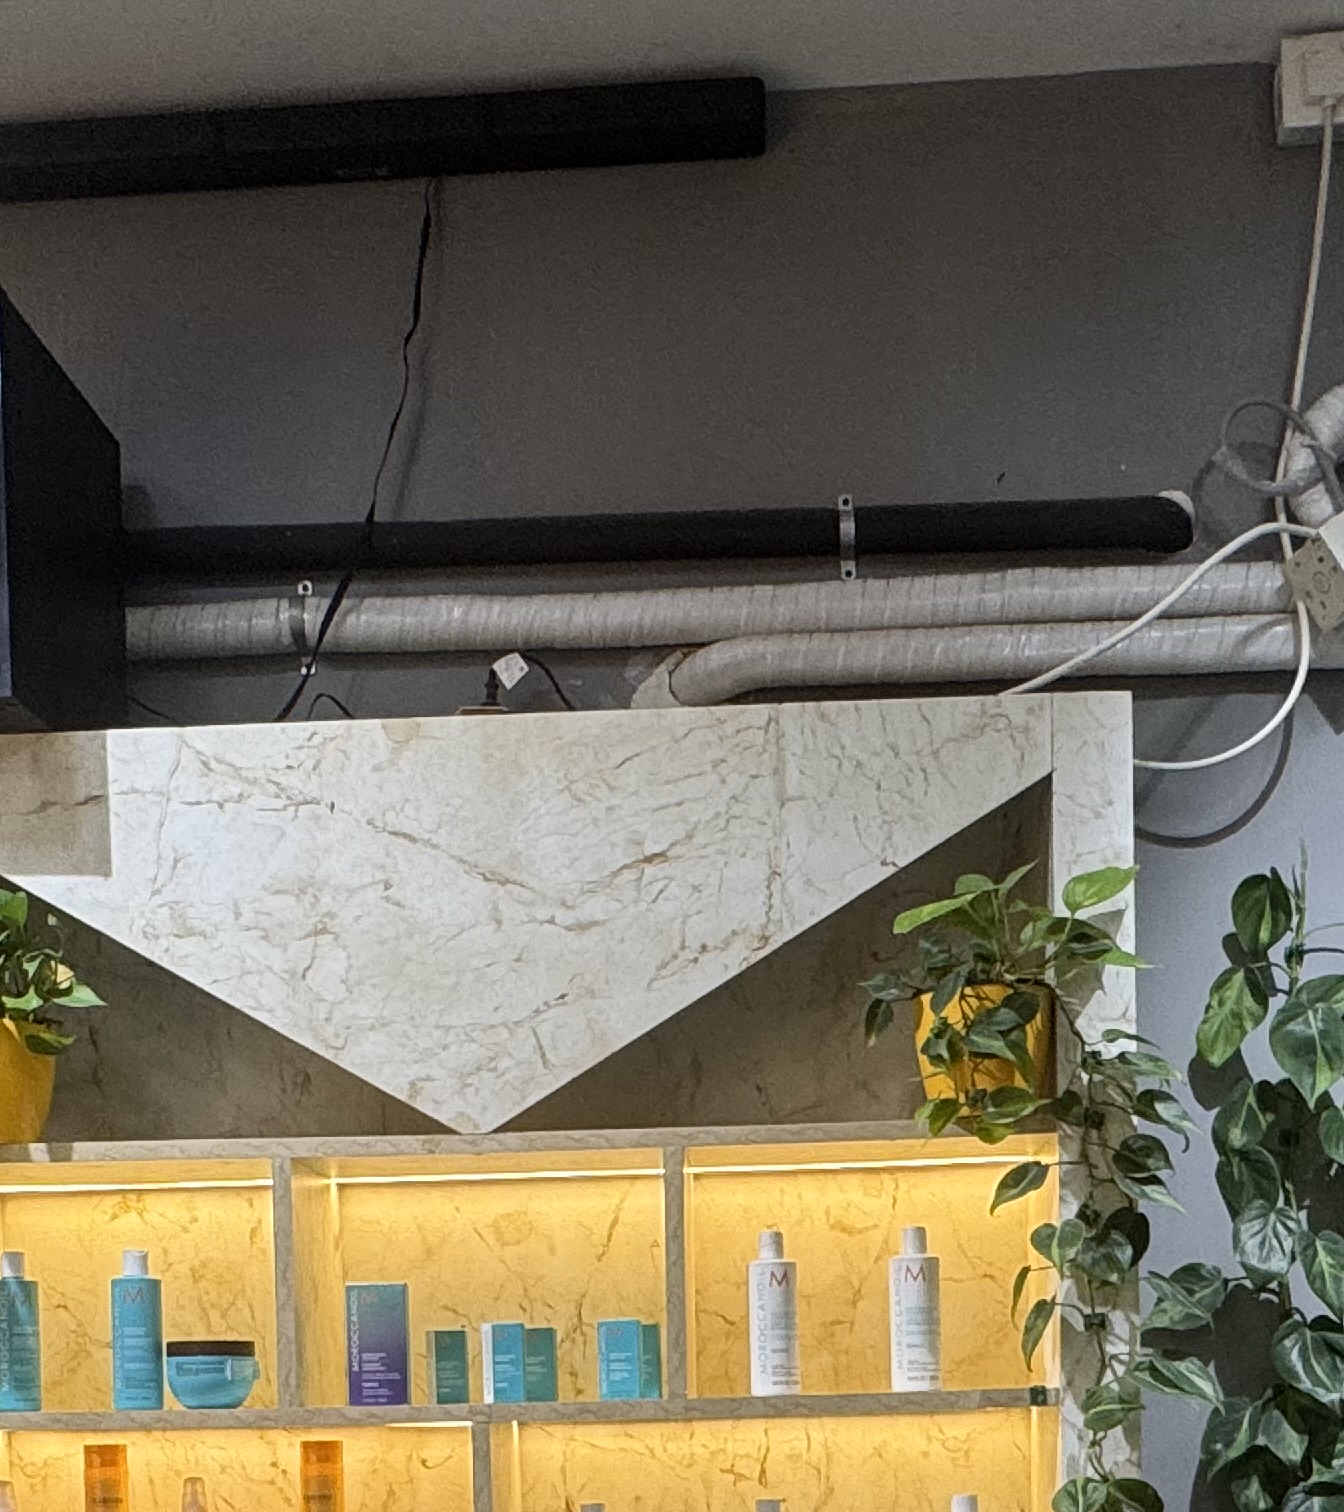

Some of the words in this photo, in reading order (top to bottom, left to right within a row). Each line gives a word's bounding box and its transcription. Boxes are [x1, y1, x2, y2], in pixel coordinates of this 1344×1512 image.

[123, 1286, 145, 1304] M
[769, 1268, 789, 1288] M
[904, 1263, 927, 1283] M
[0, 1288, 11, 1392] MOROCCANOIL
[349, 1288, 360, 1372] MOROCCANOIL
[756, 1267, 768, 1375] MOROCCANOIL
